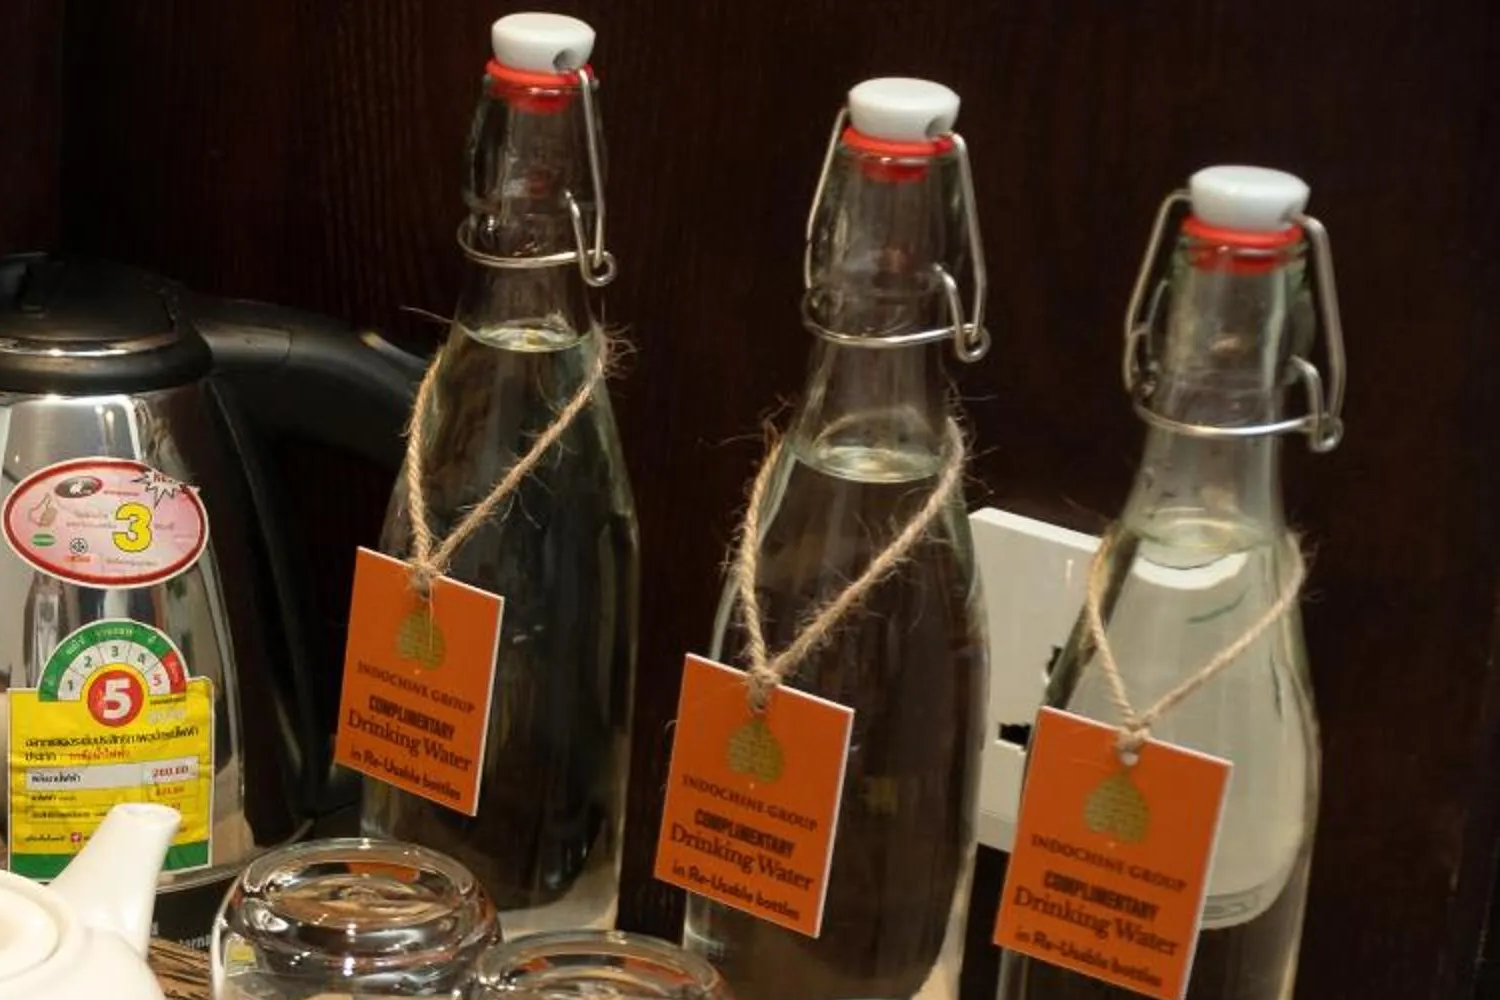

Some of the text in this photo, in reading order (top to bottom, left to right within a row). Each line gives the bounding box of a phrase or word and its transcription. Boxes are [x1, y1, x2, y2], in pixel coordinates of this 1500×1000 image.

[112, 501, 153, 553] 3
[83, 655, 94, 669] 2
[111, 645, 120, 658] 3
[66, 678, 75, 692] 1
[102, 677, 133, 720] 5
[152, 672, 163, 686] 5
[348, 709, 473, 772] Drinking Water
[682, 774, 818, 833] INDOCHINE GROUP
[671, 823, 814, 892] Drinking Water
[1014, 885, 1178, 956] Drinking Water
